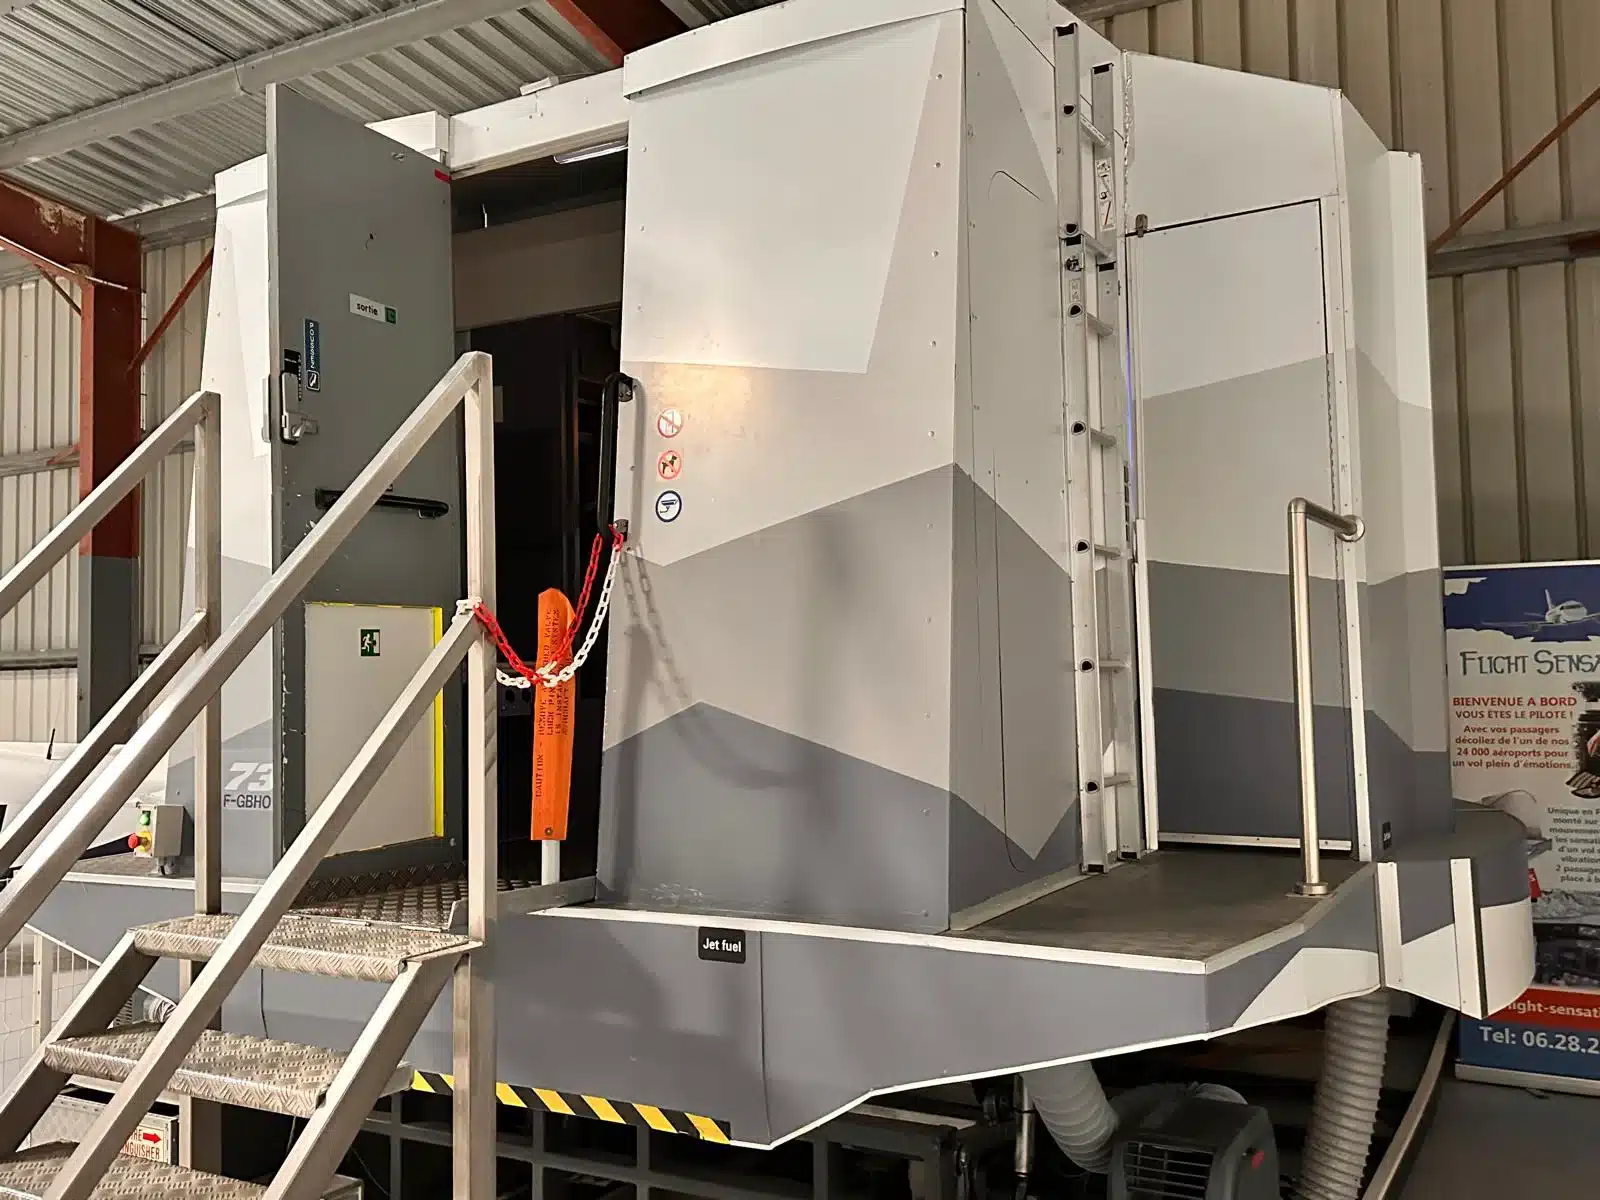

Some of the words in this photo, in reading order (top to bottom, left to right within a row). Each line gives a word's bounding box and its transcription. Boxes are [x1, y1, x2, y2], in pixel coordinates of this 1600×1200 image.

[356, 302, 379, 316] sortie
[1459, 650, 1529, 675] FLIGHT
[1453, 697, 1524, 706] BIENVENUE
[1527, 697, 1537, 706] A
[1540, 697, 1577, 706] BORD
[1456, 710, 1485, 719] VOUS
[1515, 710, 1526, 719] LE
[1530, 710, 1567, 719] PILOTE
[1464, 725, 1488, 733] Avec
[1510, 726, 1560, 736] passagers
[1455, 736, 1495, 745] décollez
[1498, 737, 1511, 745] de
[1513, 737, 1533, 745] l'un
[1535, 737, 1548, 745] de
[1457, 747, 1468, 756] 24
[1471, 747, 1490, 756] 000
[1492, 748, 1541, 758] aéroports
[1543, 750, 1568, 759] pour
[1486, 760, 1510, 769] plein
[535, 754, 544, 800] CAUTION
[223, 794, 272, 809] F-GBHO
[1547, 807, 1580, 815] Unique
[1553, 817, 1581, 825] monté
[1556, 864, 1561, 872] 2
[1560, 874, 1584, 883] place
[702, 938, 720, 951] Jet
[722, 939, 742, 953] fuel
[1508, 1000, 1600, 1018] ight-sensati
[1479, 1026, 1516, 1045] Tel:
[1522, 1030, 1600, 1055] 06.28.2
[124, 1142, 160, 1160] NGUISHER
